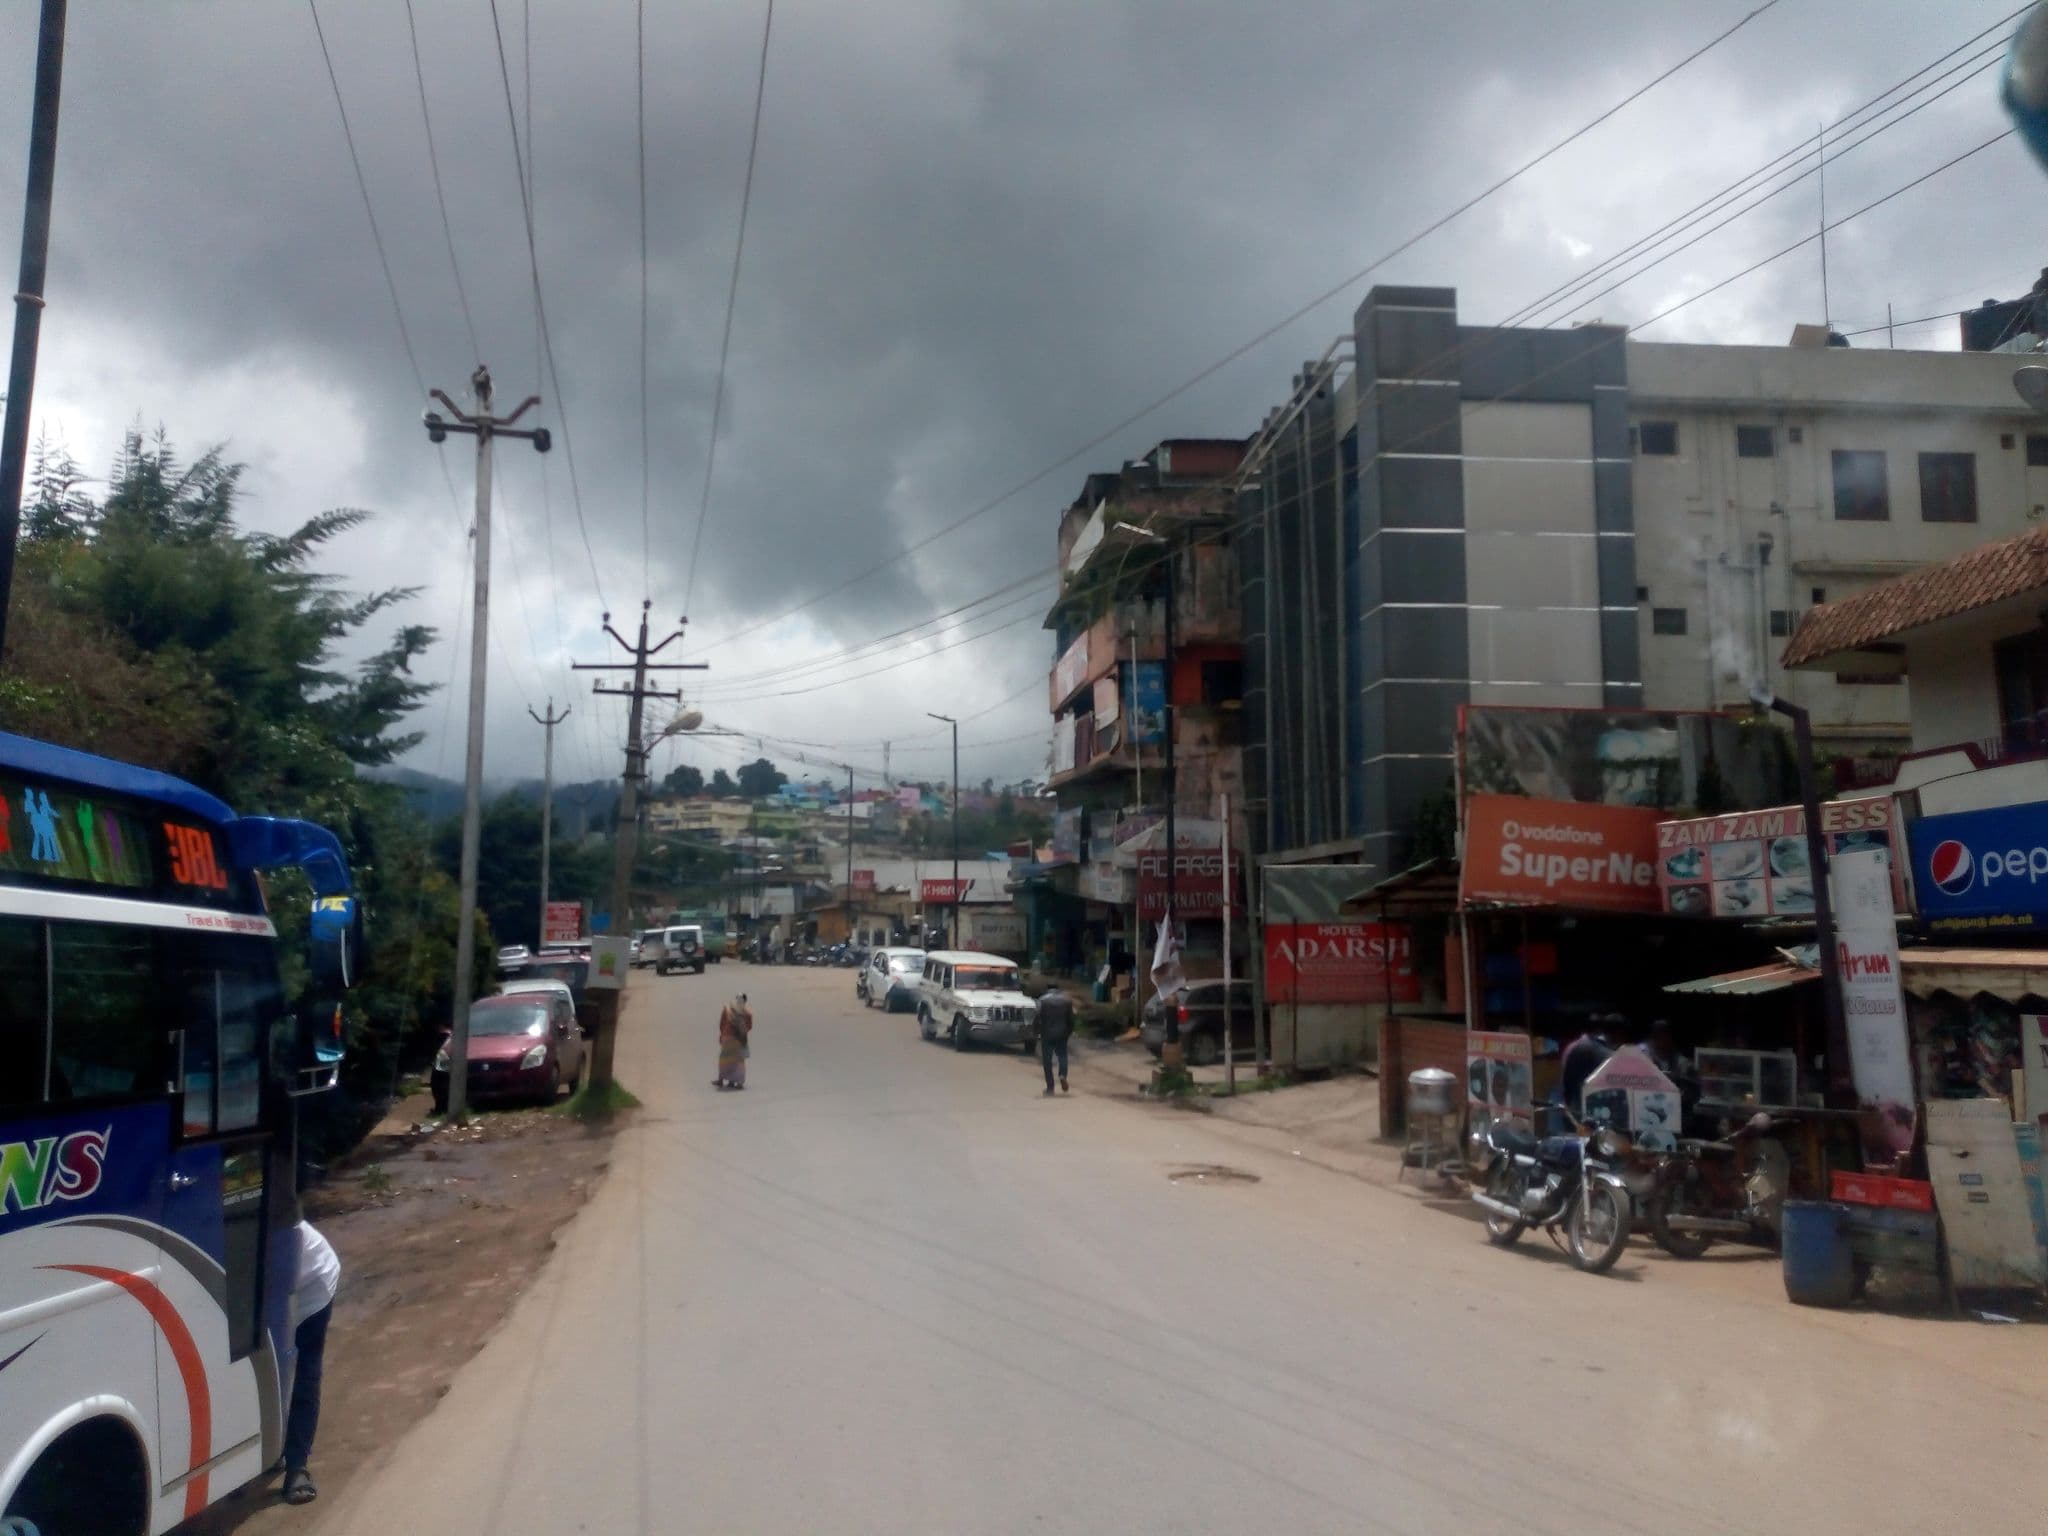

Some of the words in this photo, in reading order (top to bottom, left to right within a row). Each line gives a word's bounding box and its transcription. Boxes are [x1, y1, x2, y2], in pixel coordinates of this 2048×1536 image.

[1521, 822, 1604, 845] vodafone
[1660, 821, 1714, 848] ZAM
[1723, 813, 1785, 842] ZAM
[162, 822, 228, 889] JBL
[1500, 842, 1659, 887] SuperNe
[1144, 891, 1240, 909] INTERNATIONL
[1318, 925, 1368, 936] HOTEL
[1273, 937, 1411, 965] ADARSH
[1839, 941, 1891, 983] Arun
